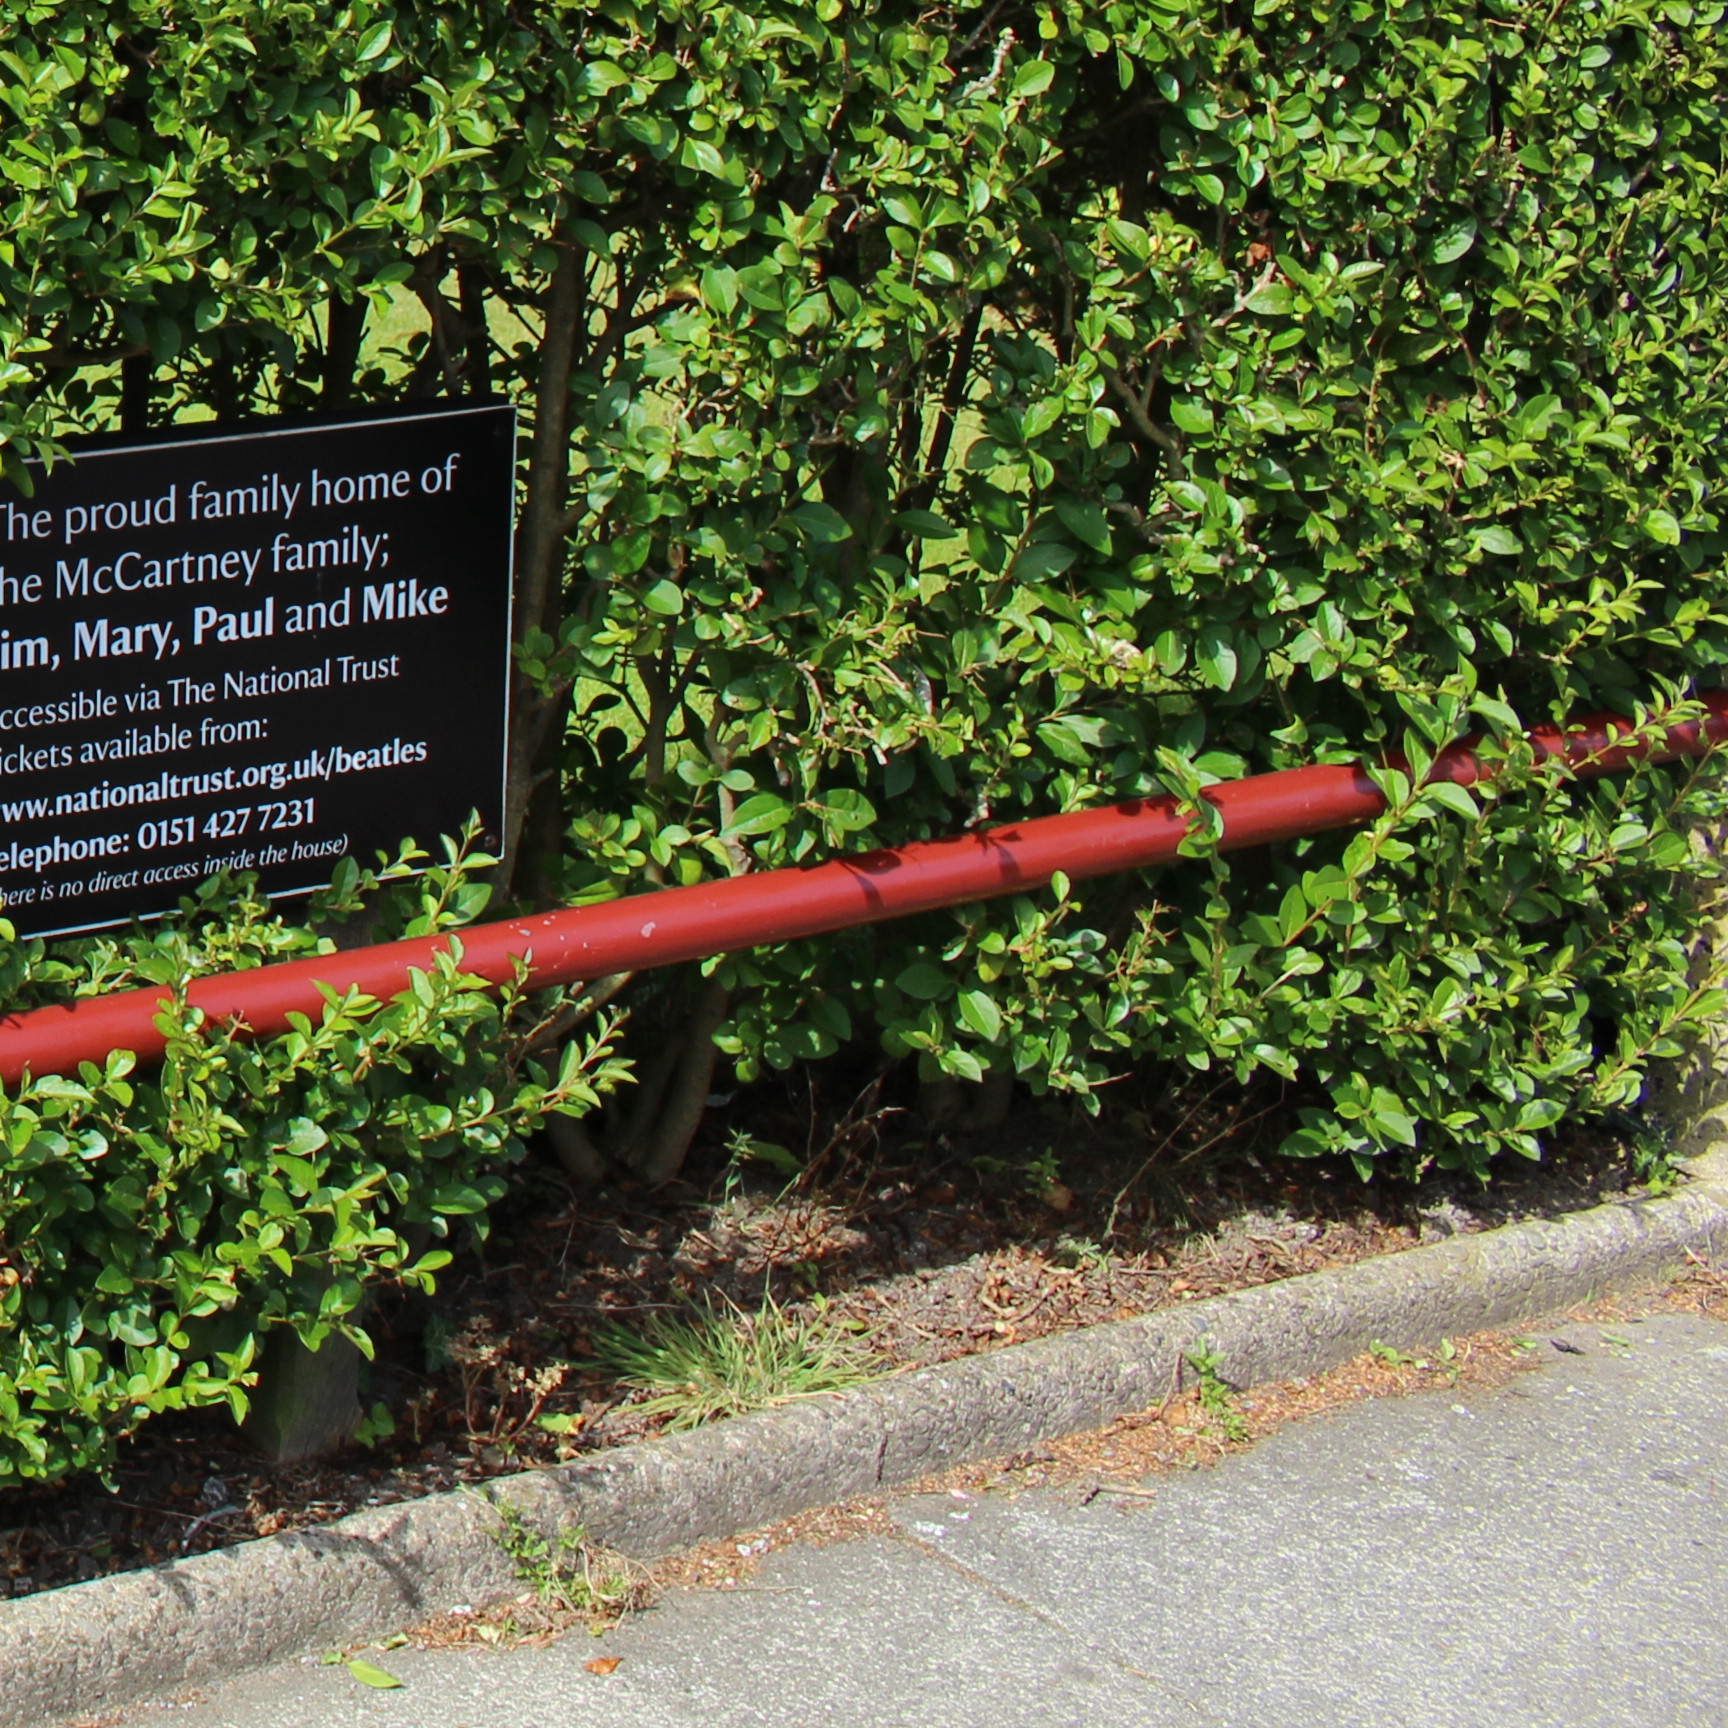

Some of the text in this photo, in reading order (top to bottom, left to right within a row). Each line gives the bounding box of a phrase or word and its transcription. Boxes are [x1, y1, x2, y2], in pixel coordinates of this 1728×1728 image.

[64, 484, 176, 545] proud
[188, 473, 301, 521] family
[311, 469, 410, 507] home
[421, 453, 461, 493] of
[55, 548, 262, 599] McCartney
[271, 525, 389, 572] family;
[74, 619, 180, 661] Mary,
[193, 596, 274, 646] Paul
[285, 587, 350, 633] and
[363, 578, 449, 623] Mike
[124, 683, 161, 713] via
[167, 677, 215, 707] The
[223, 658, 330, 699] National
[337, 654, 400, 683] Trust
[79, 723, 192, 764] available
[200, 717, 268, 747] from:
[137, 816, 195, 850] 0151
[202, 807, 251, 839] 427
[257, 797, 314, 831] 7231
[40, 880, 55, 901] is
[59, 881, 84, 898] no
[88, 871, 139, 893] direct
[144, 860, 199, 884] access
[258, 842, 287, 866] the
[291, 833, 349, 860] house)
